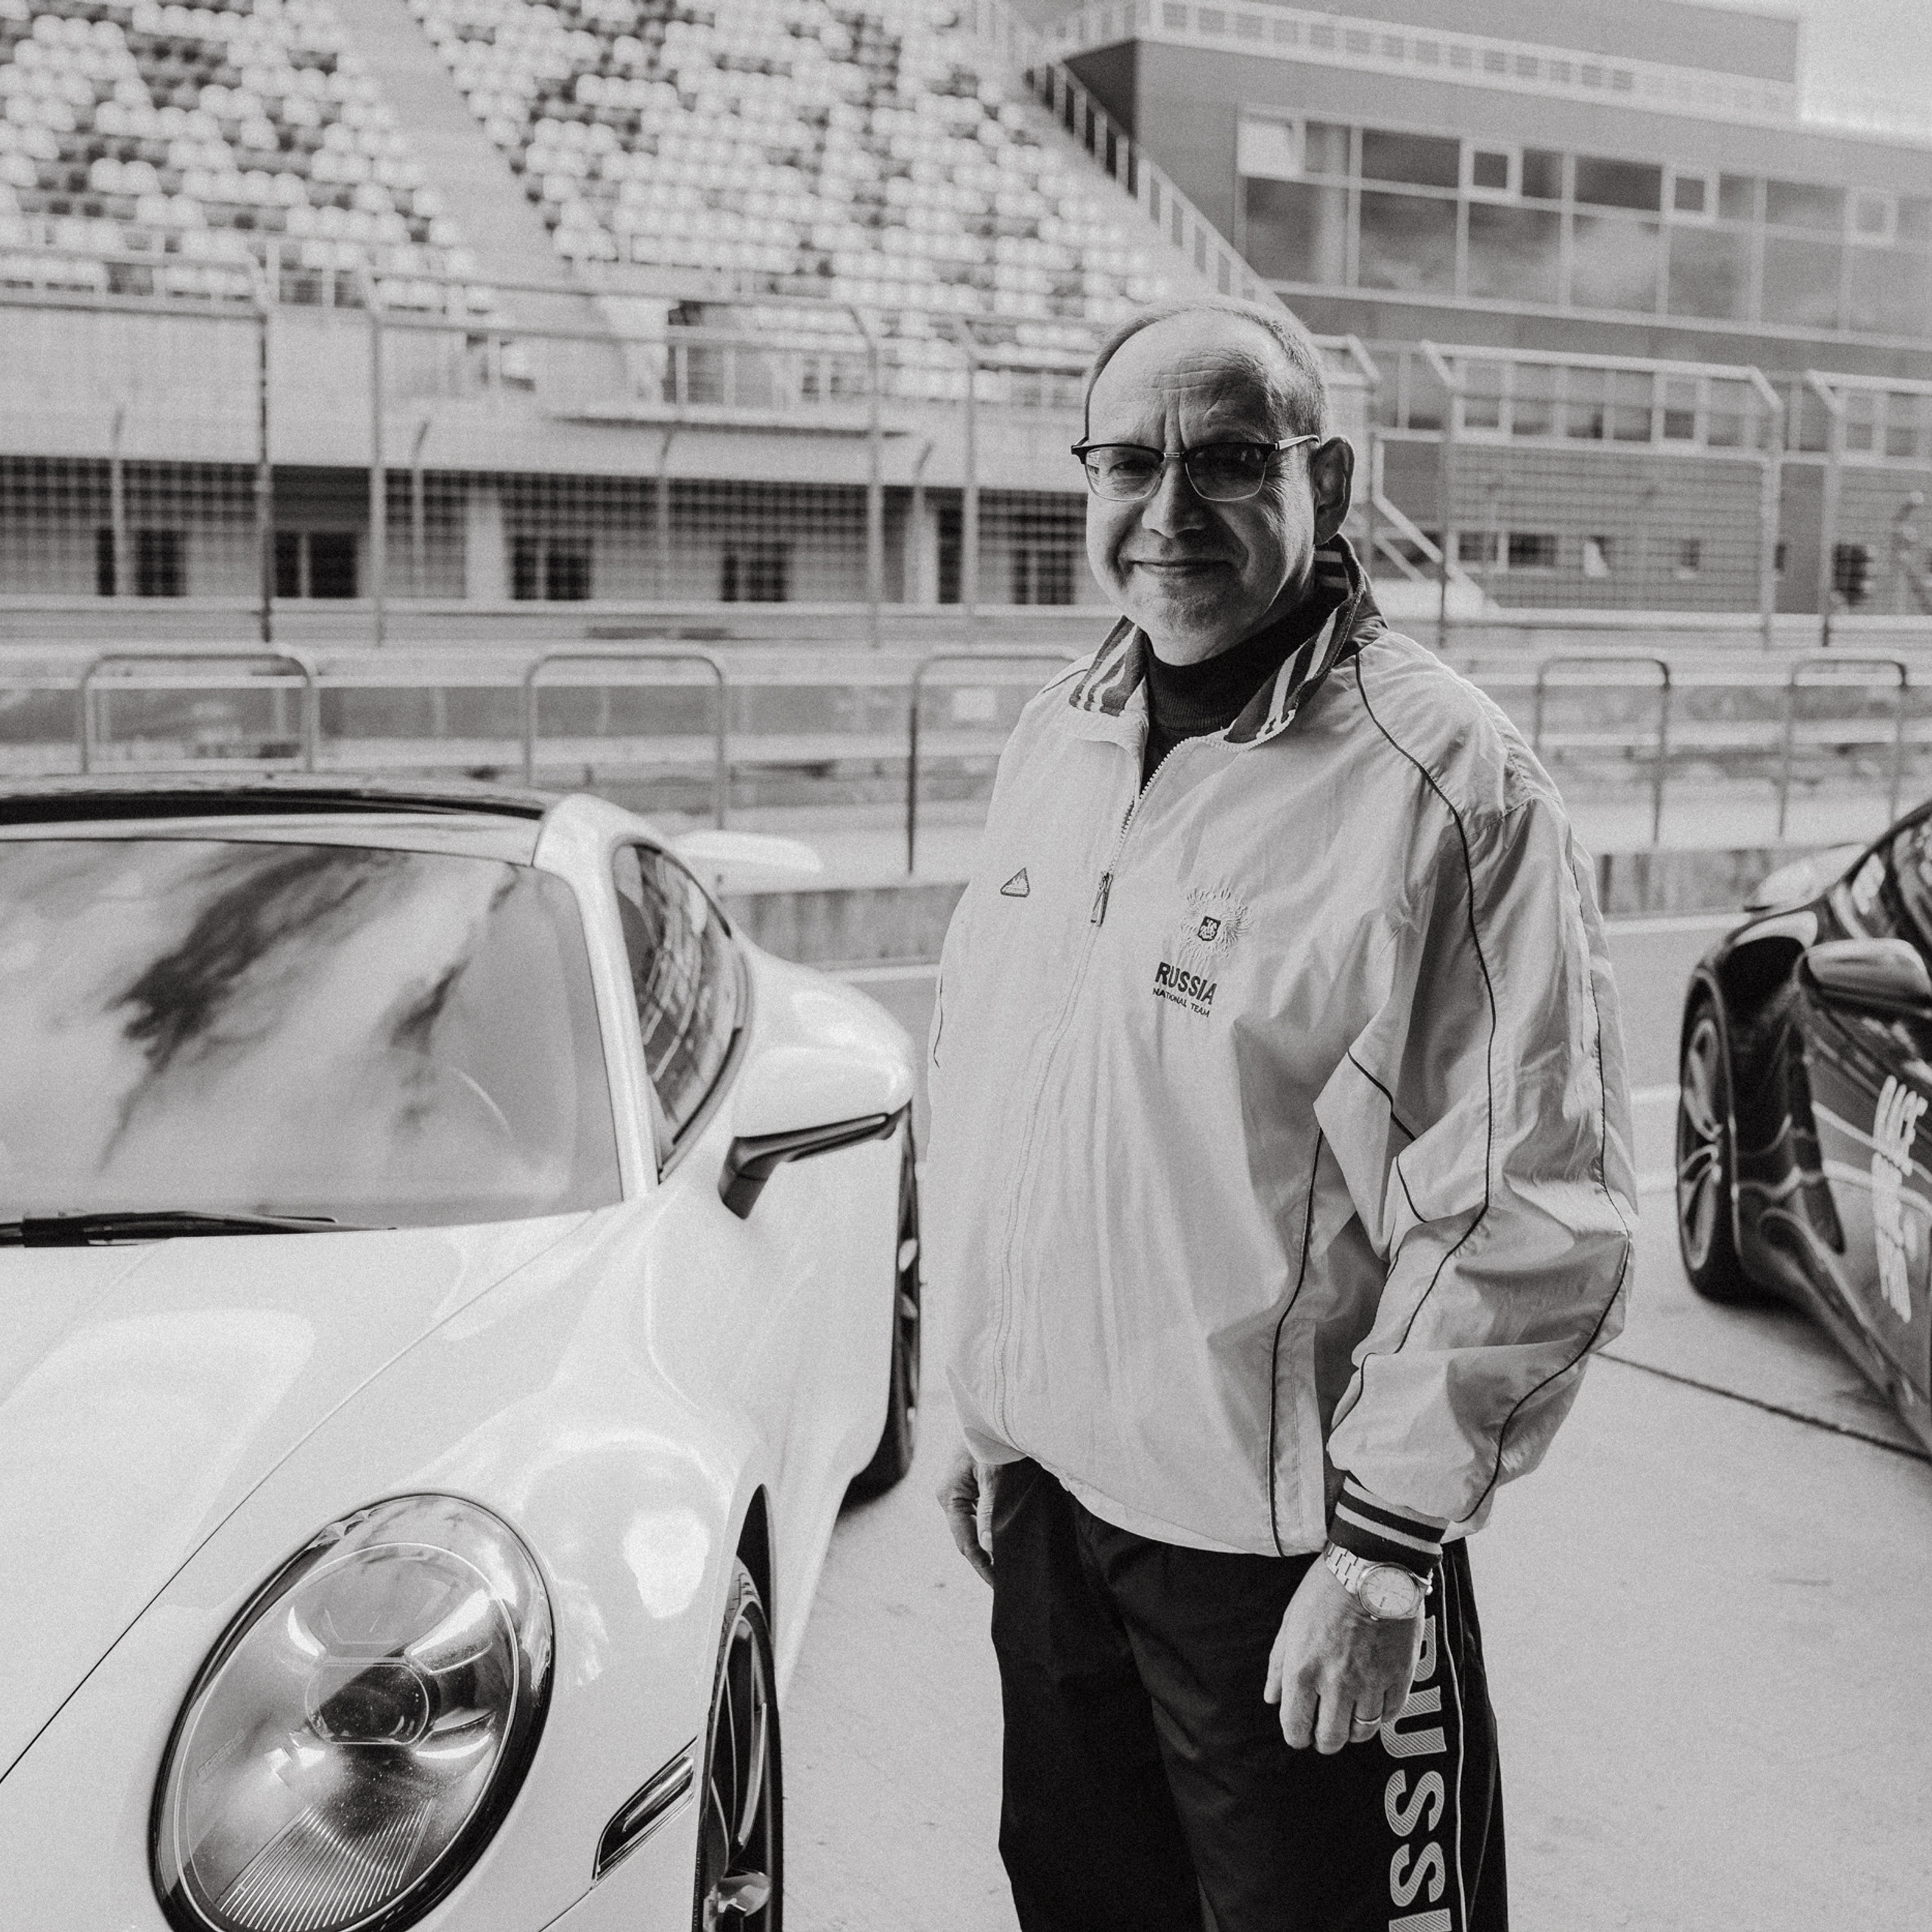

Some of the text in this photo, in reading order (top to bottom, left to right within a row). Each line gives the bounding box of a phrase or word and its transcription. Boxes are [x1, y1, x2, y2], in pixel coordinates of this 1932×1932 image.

[1155, 961, 1217, 1005] RUSSIA
[1152, 988, 1211, 1017] NATIONAL TEAM
